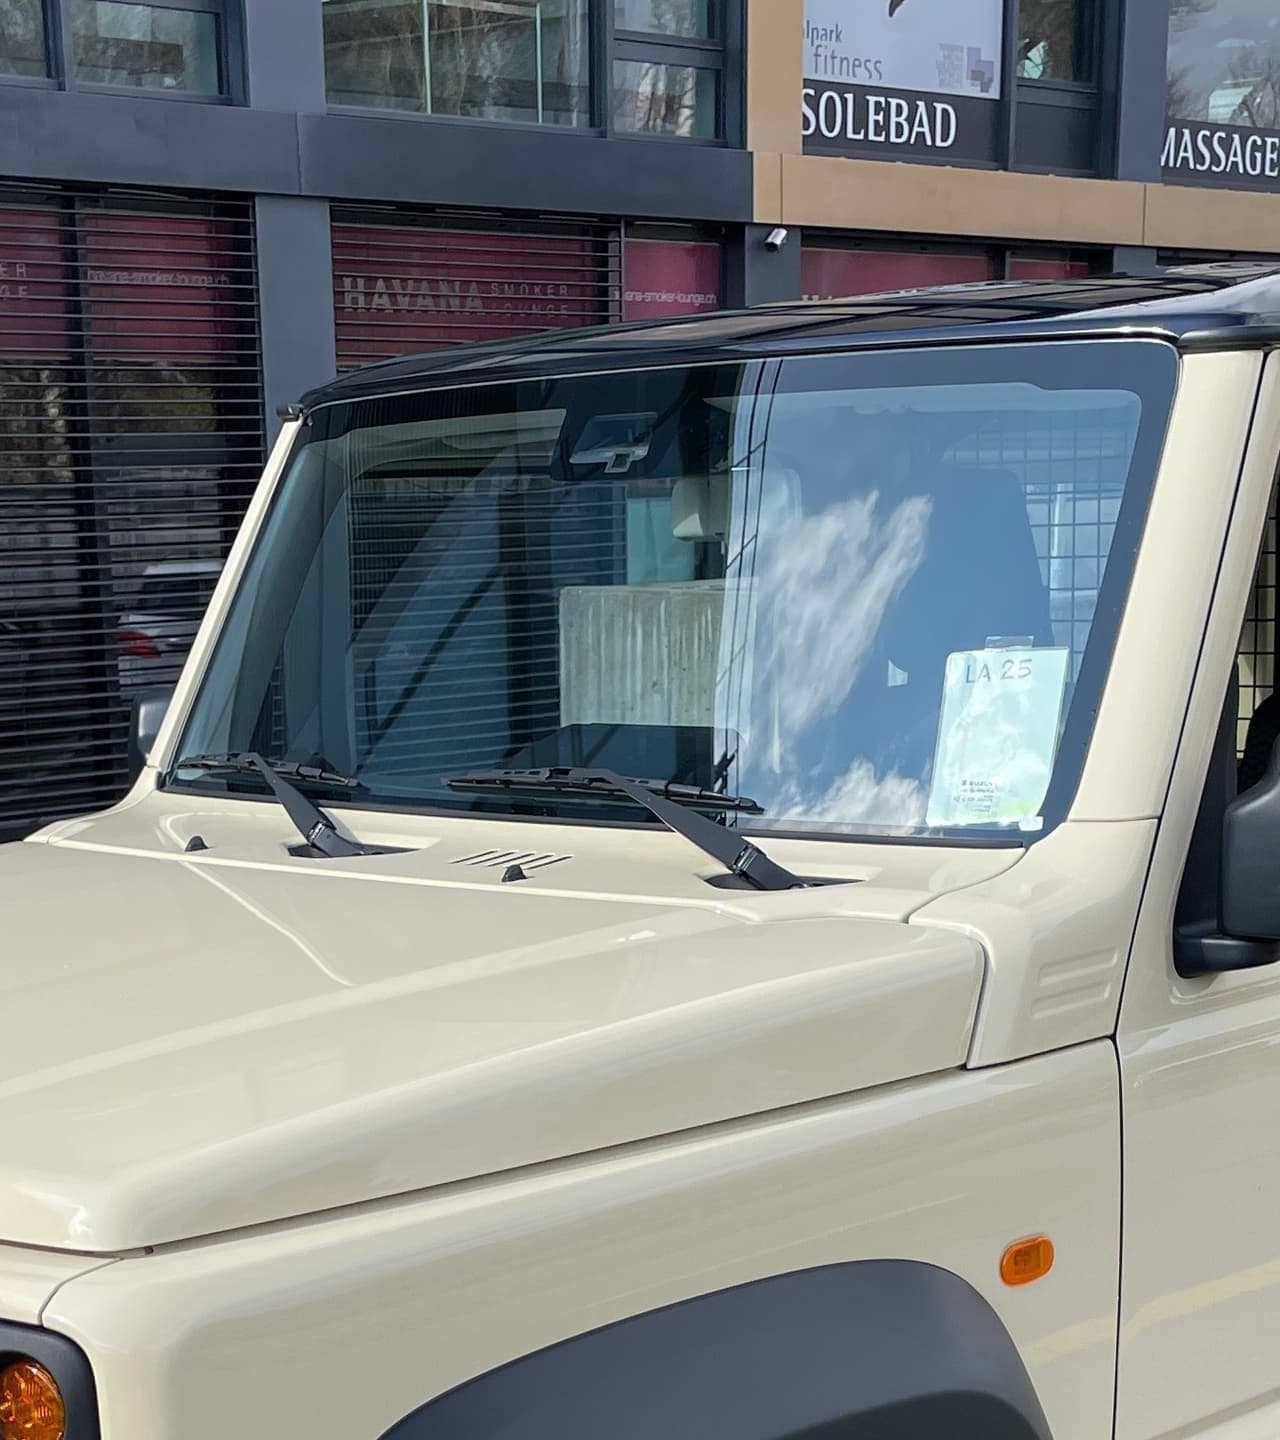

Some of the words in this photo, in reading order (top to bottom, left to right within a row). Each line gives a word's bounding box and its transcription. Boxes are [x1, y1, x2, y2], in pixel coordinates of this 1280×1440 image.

[802, 19, 843, 47] lpark
[813, 45, 883, 81] fitness
[801, 88, 957, 148] SOLEBAD
[342, 277, 486, 315] HAVANA
[490, 282, 569, 297] SMOKER
[966, 663, 991, 684] LA
[1000, 658, 1033, 681] 25
